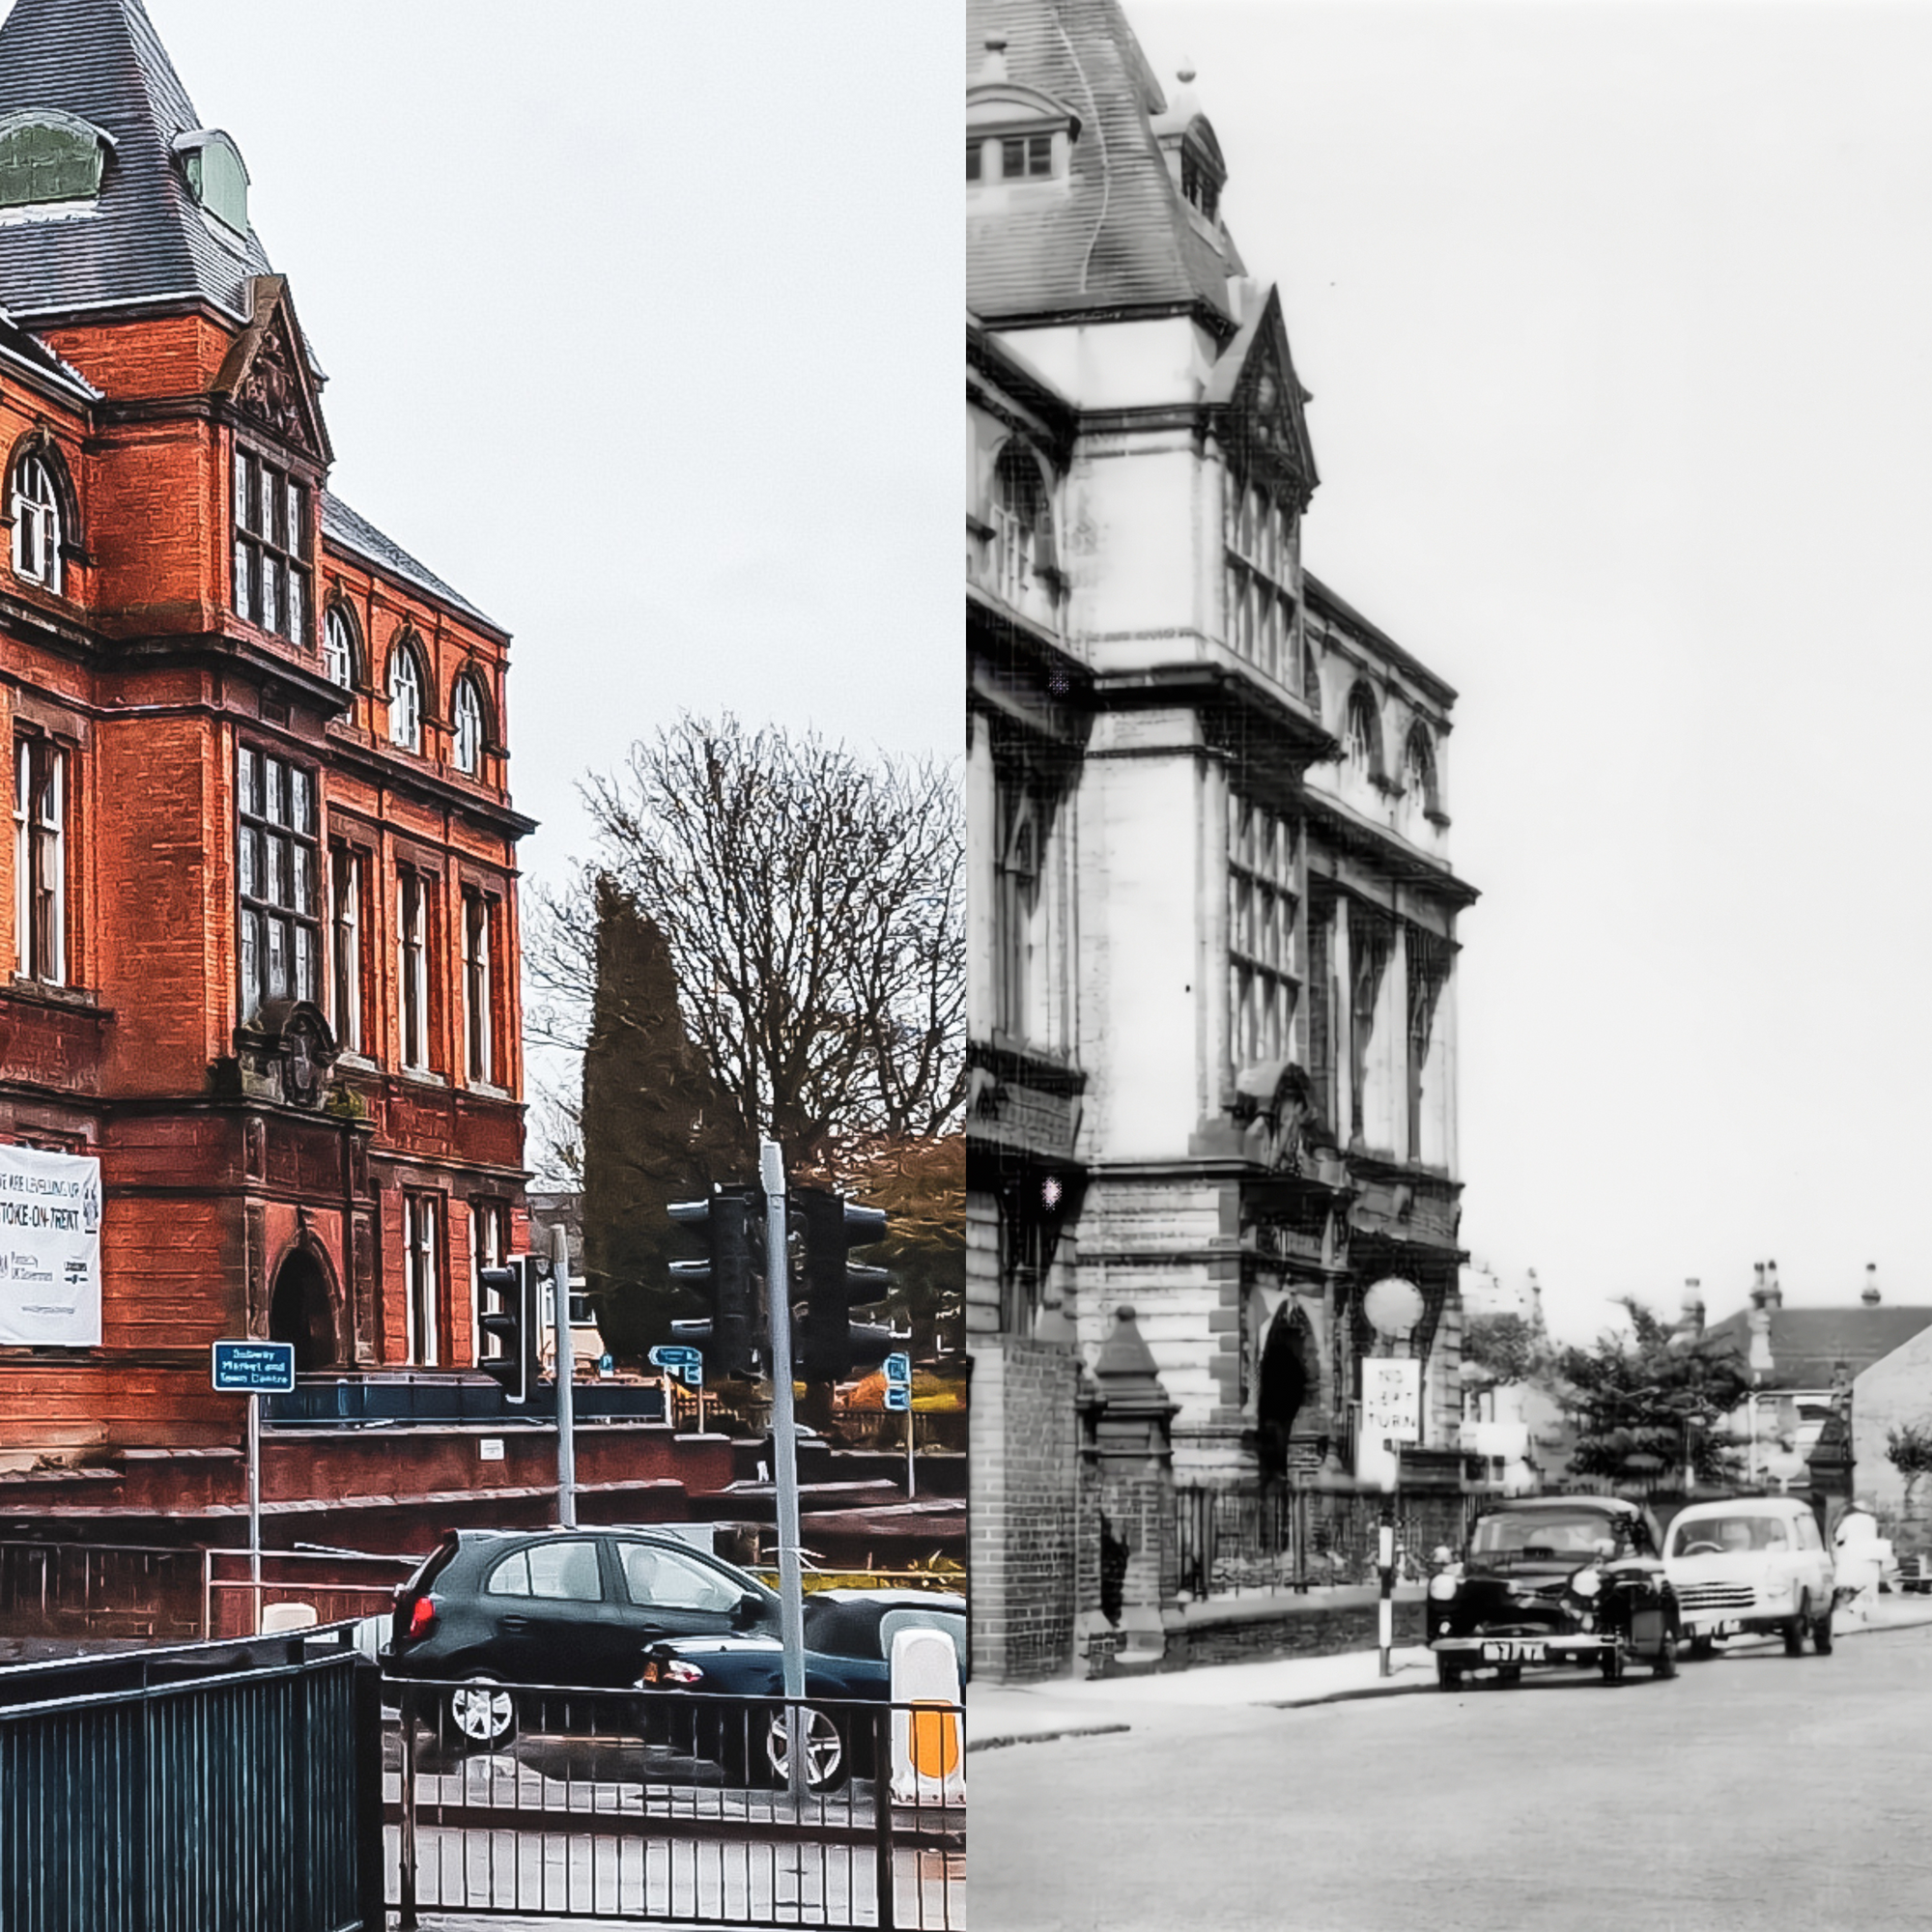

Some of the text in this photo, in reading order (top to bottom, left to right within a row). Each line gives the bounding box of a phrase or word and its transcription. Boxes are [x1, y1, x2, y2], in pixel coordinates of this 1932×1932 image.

[0, 1202, 79, 1231] TOKE-ON-TRENT
[265, 1362, 285, 1372] and
[251, 1373, 288, 1384] Centre
[1368, 1412, 1416, 1429] TURN
